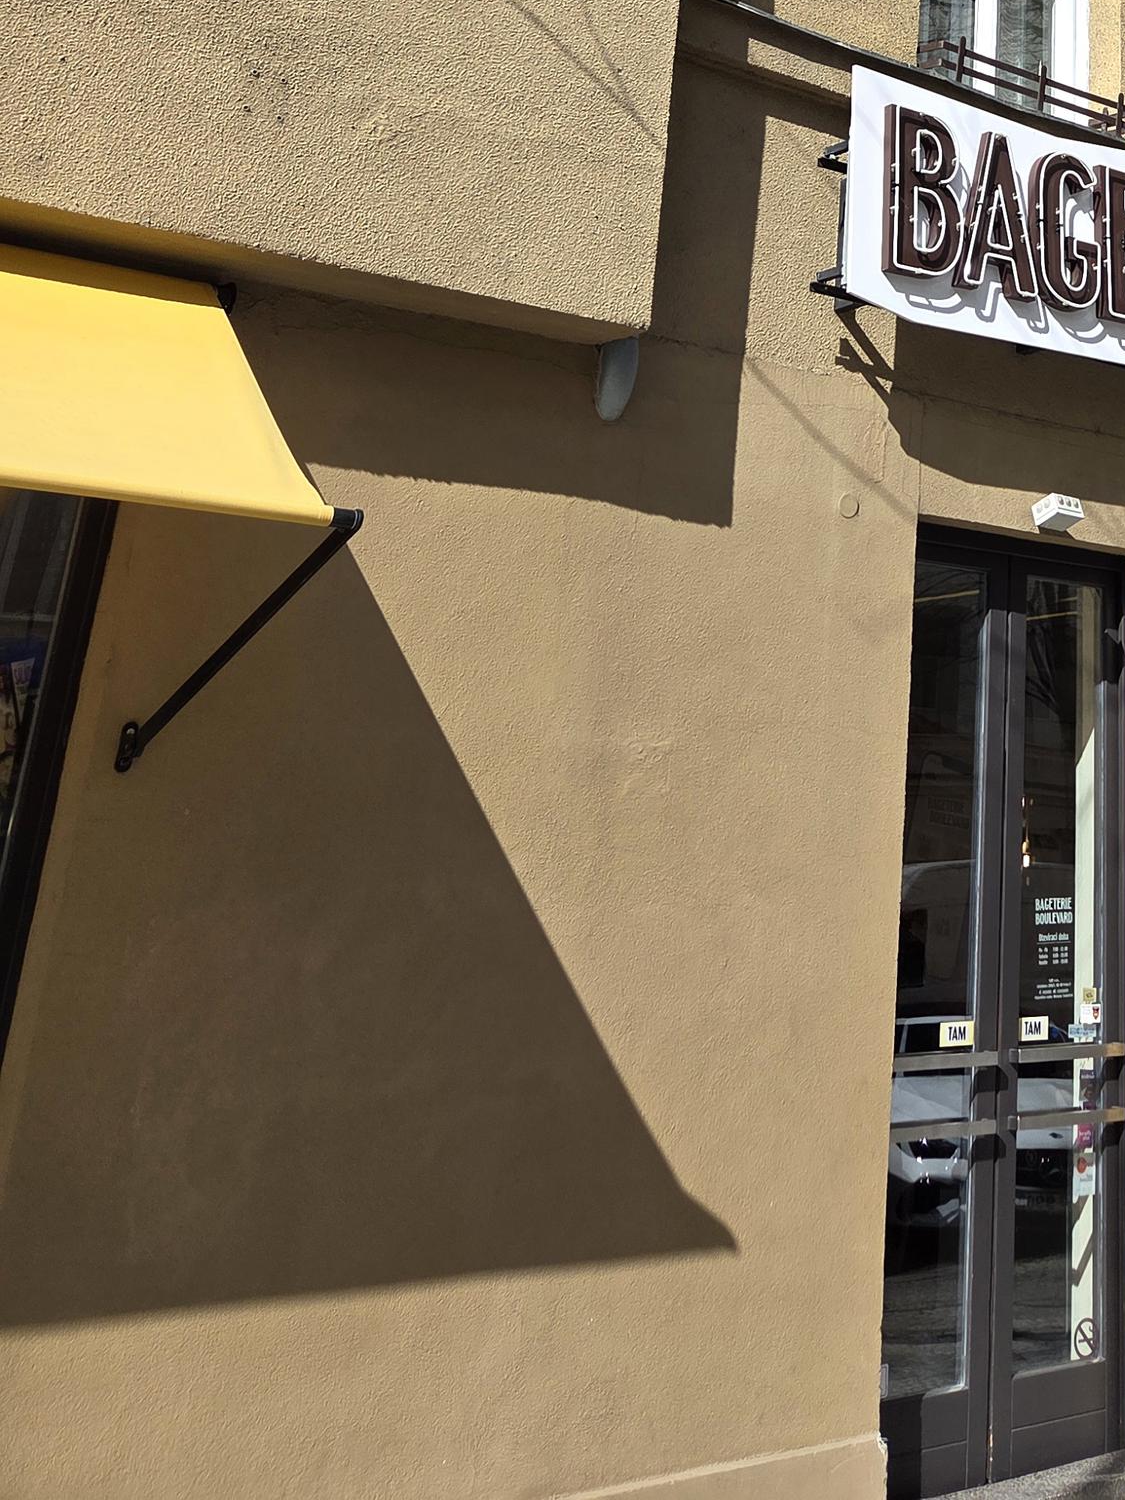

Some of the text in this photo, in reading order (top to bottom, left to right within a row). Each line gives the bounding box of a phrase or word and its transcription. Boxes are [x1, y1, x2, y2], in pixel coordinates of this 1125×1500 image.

[1035, 897, 1072, 911] BAGETERIE
[1035, 912, 1073, 925] BOULEVARD
[948, 1026, 966, 1041] TAM
[1024, 1021, 1041, 1035] TAM
